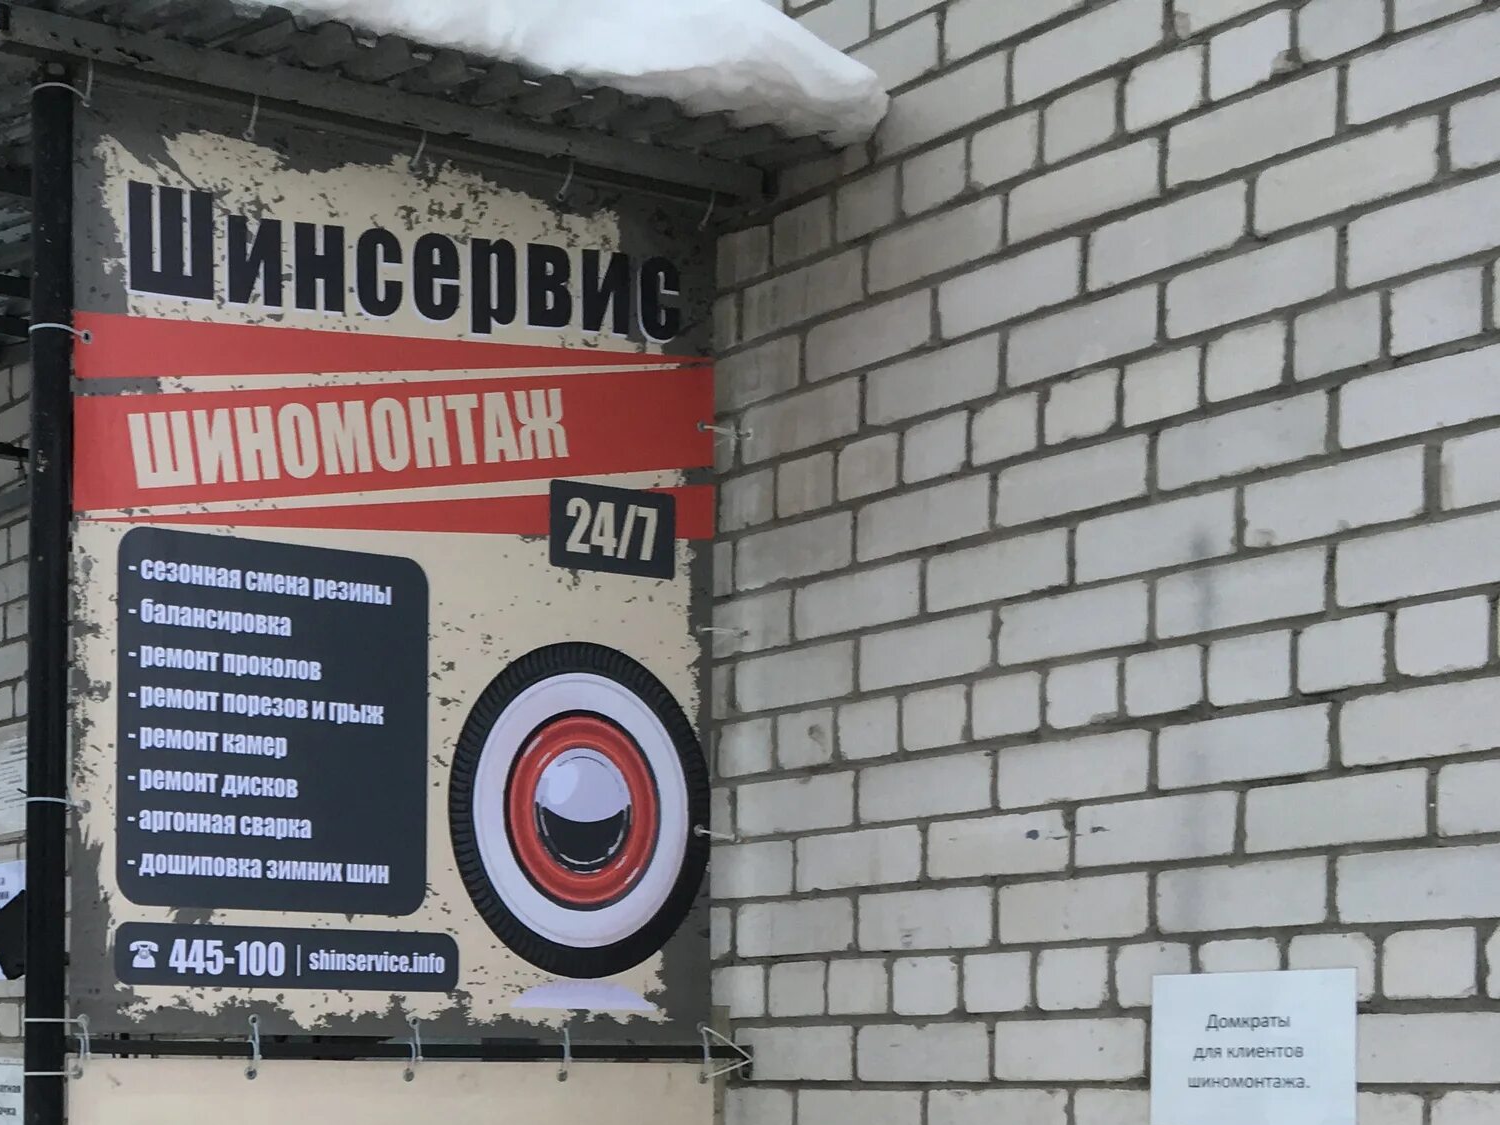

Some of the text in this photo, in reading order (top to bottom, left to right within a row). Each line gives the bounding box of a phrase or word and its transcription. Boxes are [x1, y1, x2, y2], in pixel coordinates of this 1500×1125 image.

[128, 180, 681, 341] Шинсервис
[127, 388, 569, 489] ШИНОМОНТАЖ
[565, 497, 658, 561] 24/7
[140, 559, 392, 605] сезонная смена резины
[140, 598, 292, 636] балансировка
[140, 645, 322, 681] ремонт проколов
[140, 686, 384, 725] ремонт порезов и грыж
[139, 726, 288, 759] ремонт камер
[139, 768, 299, 798] ремонт дисков
[139, 809, 312, 840] аргонная сварка
[138, 853, 390, 884] дошиповка зимних шин
[168, 938, 286, 977] 445-100
[308, 949, 446, 974] shinservice.info
[1205, 1013, 1291, 1031] Домкраты
[1193, 1044, 1304, 1060] для клиентов
[1187, 1075, 1311, 1089] шиномонтажа.
